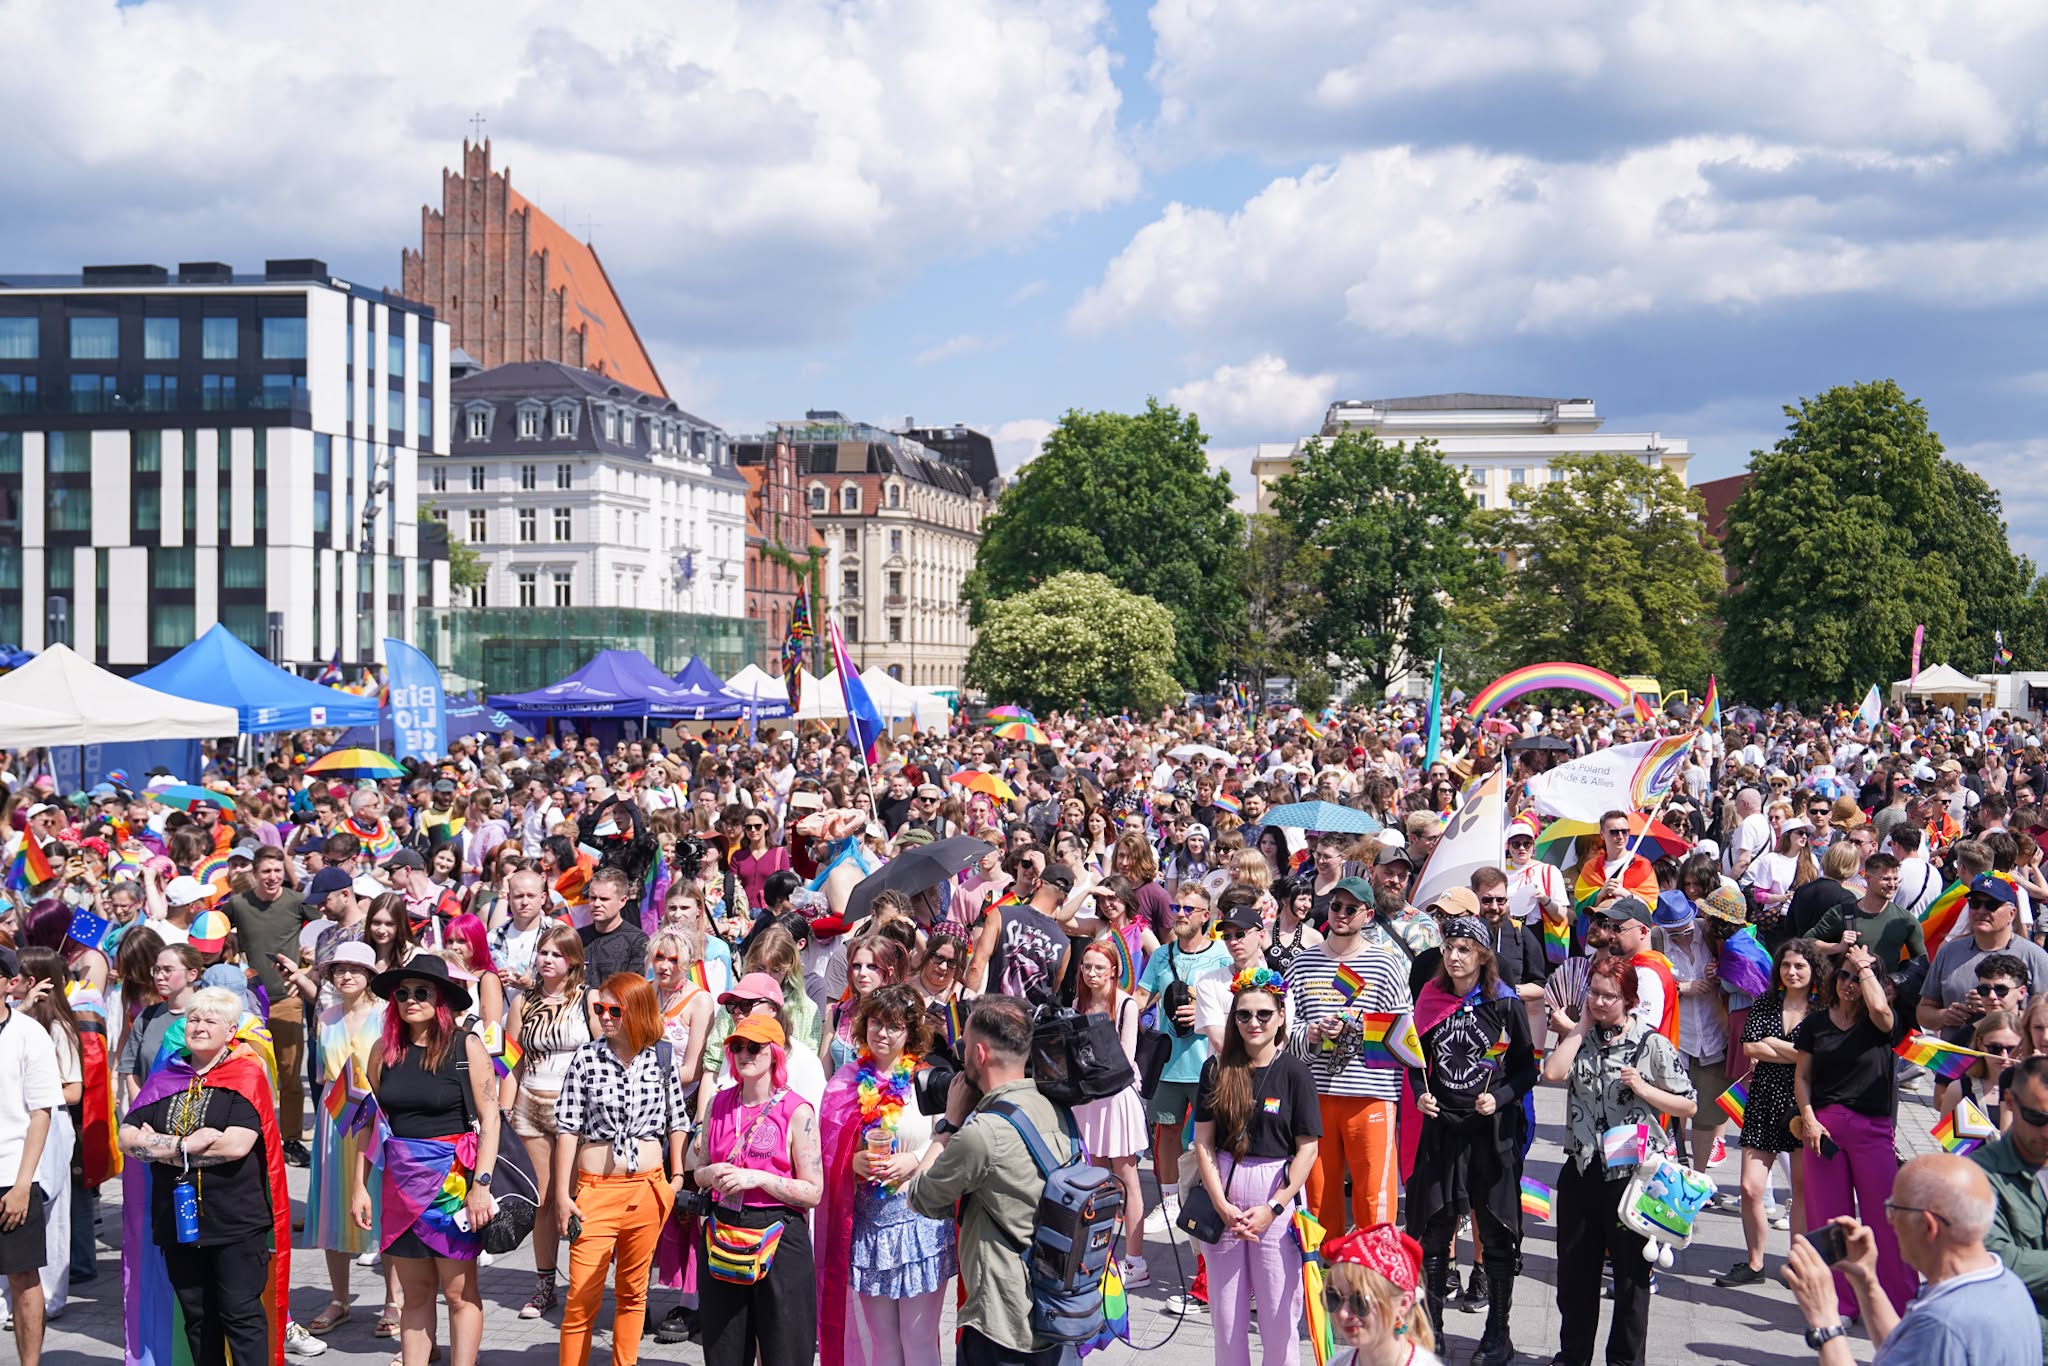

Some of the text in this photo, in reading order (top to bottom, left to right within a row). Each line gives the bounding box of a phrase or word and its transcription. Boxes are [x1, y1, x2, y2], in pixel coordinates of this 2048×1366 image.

[1579, 763, 1610, 775] Poland
[1555, 771, 1615, 788] Pride & Allies
